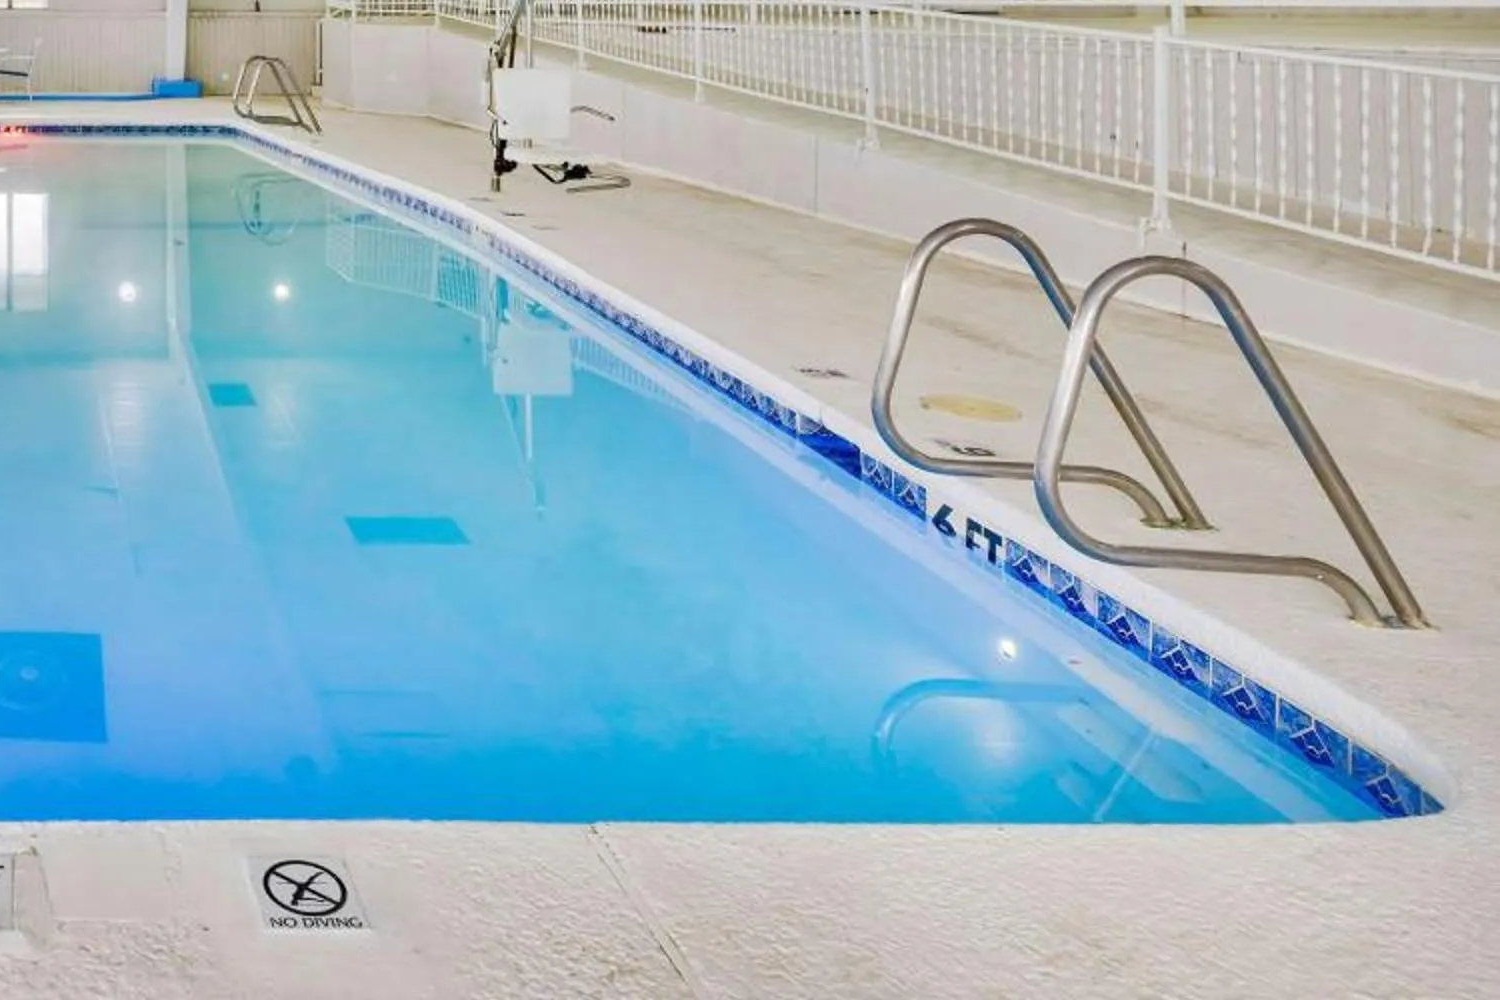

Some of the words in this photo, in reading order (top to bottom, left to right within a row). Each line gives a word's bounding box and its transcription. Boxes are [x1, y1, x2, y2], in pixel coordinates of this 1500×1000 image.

[931, 503, 957, 538] 6
[965, 516, 1003, 566] FT
[269, 917, 298, 929] NO
[302, 917, 363, 929] DIVING
